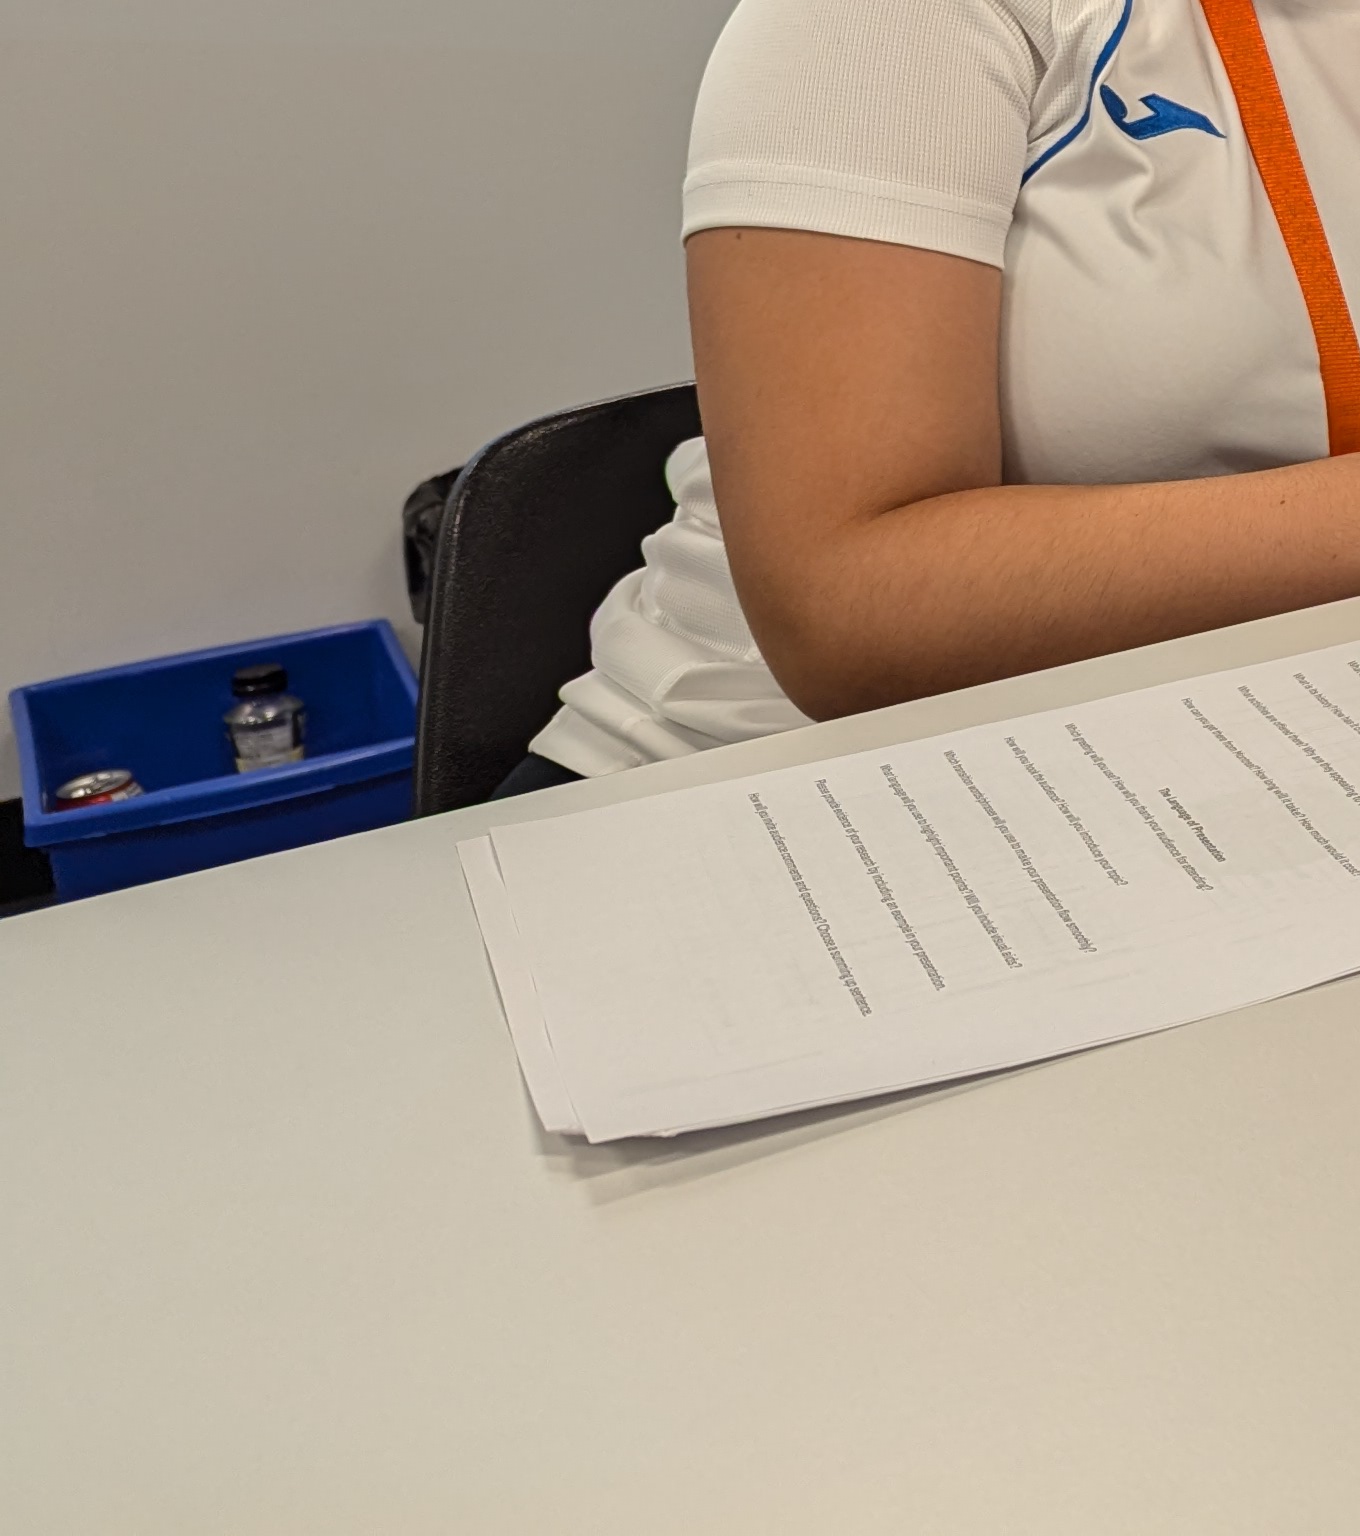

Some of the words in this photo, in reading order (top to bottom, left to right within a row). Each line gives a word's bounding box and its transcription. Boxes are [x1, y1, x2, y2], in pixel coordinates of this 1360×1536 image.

[1157, 787, 1171, 797] The
[1165, 795, 1192, 820] Language
[1185, 819, 1200, 827] of
[1190, 825, 1226, 862] Presentation
